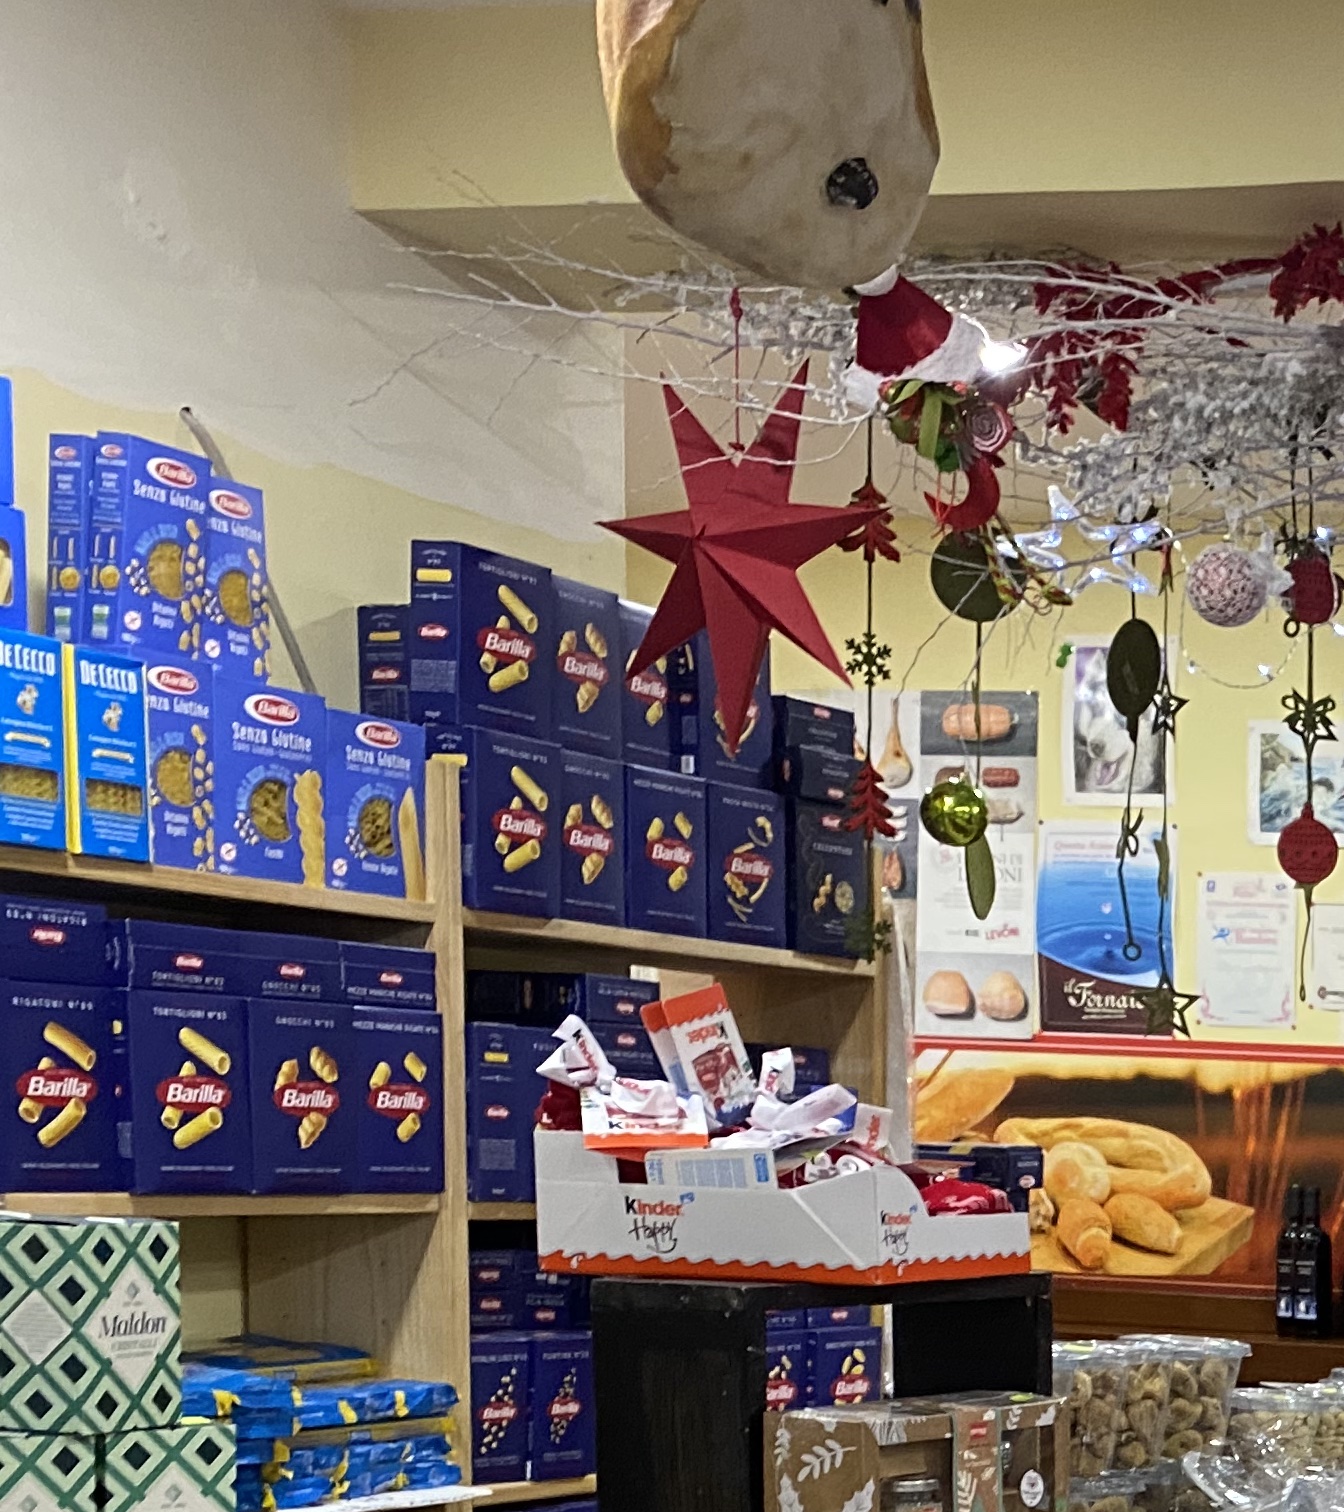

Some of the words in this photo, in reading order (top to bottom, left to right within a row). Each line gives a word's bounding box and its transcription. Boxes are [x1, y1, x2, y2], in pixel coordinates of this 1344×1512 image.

[484, 633, 530, 658] Barilla
[15, 643, 56, 676] CECCO
[564, 657, 607, 681] Barilla
[80, 660, 98, 687] DE
[100, 664, 138, 695] CECCO
[629, 675, 666, 699] Barilla
[256, 698, 300, 721] Barilla
[270, 725, 312, 753] Glutine
[500, 814, 542, 836] Barilla
[570, 830, 610, 851] Barilla
[652, 844, 691, 865] Barilla
[731, 858, 770, 878] Barilla
[28, 1076, 91, 1099] Barilla
[167, 1082, 225, 1104] Barilla
[282, 1089, 335, 1109] Barilla
[376, 1090, 424, 1111] Barilla
[625, 1195, 684, 1216] Kinder
[881, 1210, 912, 1226] Kinder
[99, 1314, 167, 1338] Maldon
